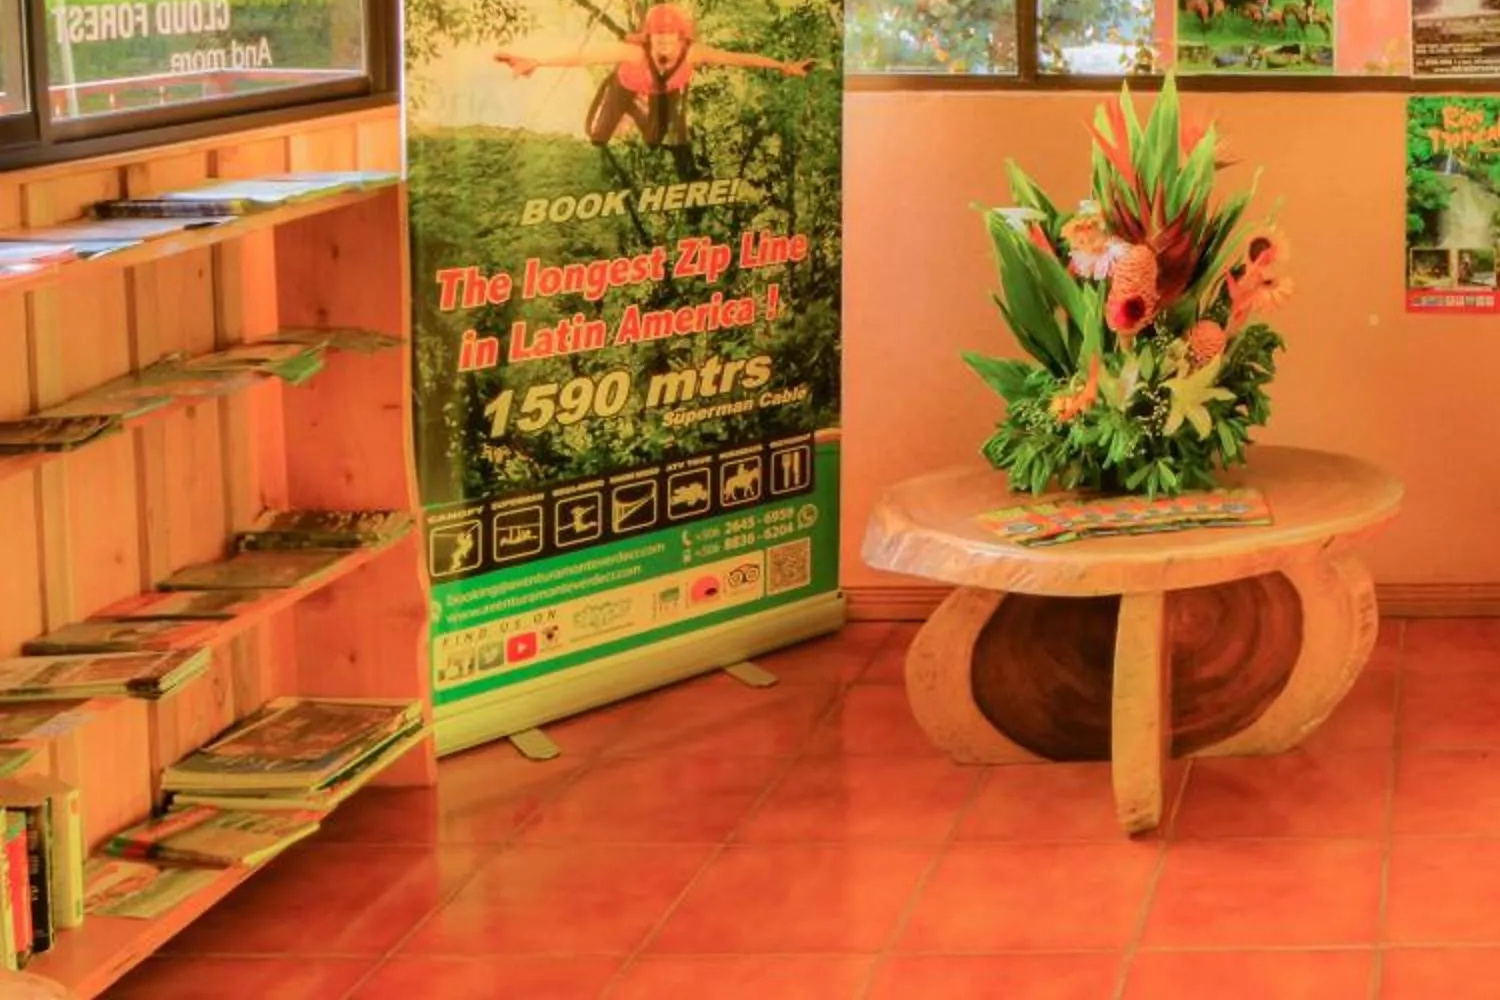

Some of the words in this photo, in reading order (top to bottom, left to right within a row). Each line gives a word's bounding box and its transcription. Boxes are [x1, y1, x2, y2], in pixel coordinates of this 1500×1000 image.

[520, 189, 629, 226] BOOK
[638, 179, 741, 212] HERE!
[436, 265, 512, 311] The
[521, 244, 666, 300] longest
[672, 236, 731, 281] Zip
[740, 230, 809, 270] Line
[457, 329, 498, 372] in
[508, 312, 606, 363] Latin
[615, 294, 755, 346] America
[483, 368, 631, 439] 1590
[646, 354, 772, 408] mtrs
[662, 399, 754, 428] Superman
[759, 385, 809, 410] Cable
[443, 627, 487, 647] FIND
[533, 609, 557, 625] ON
